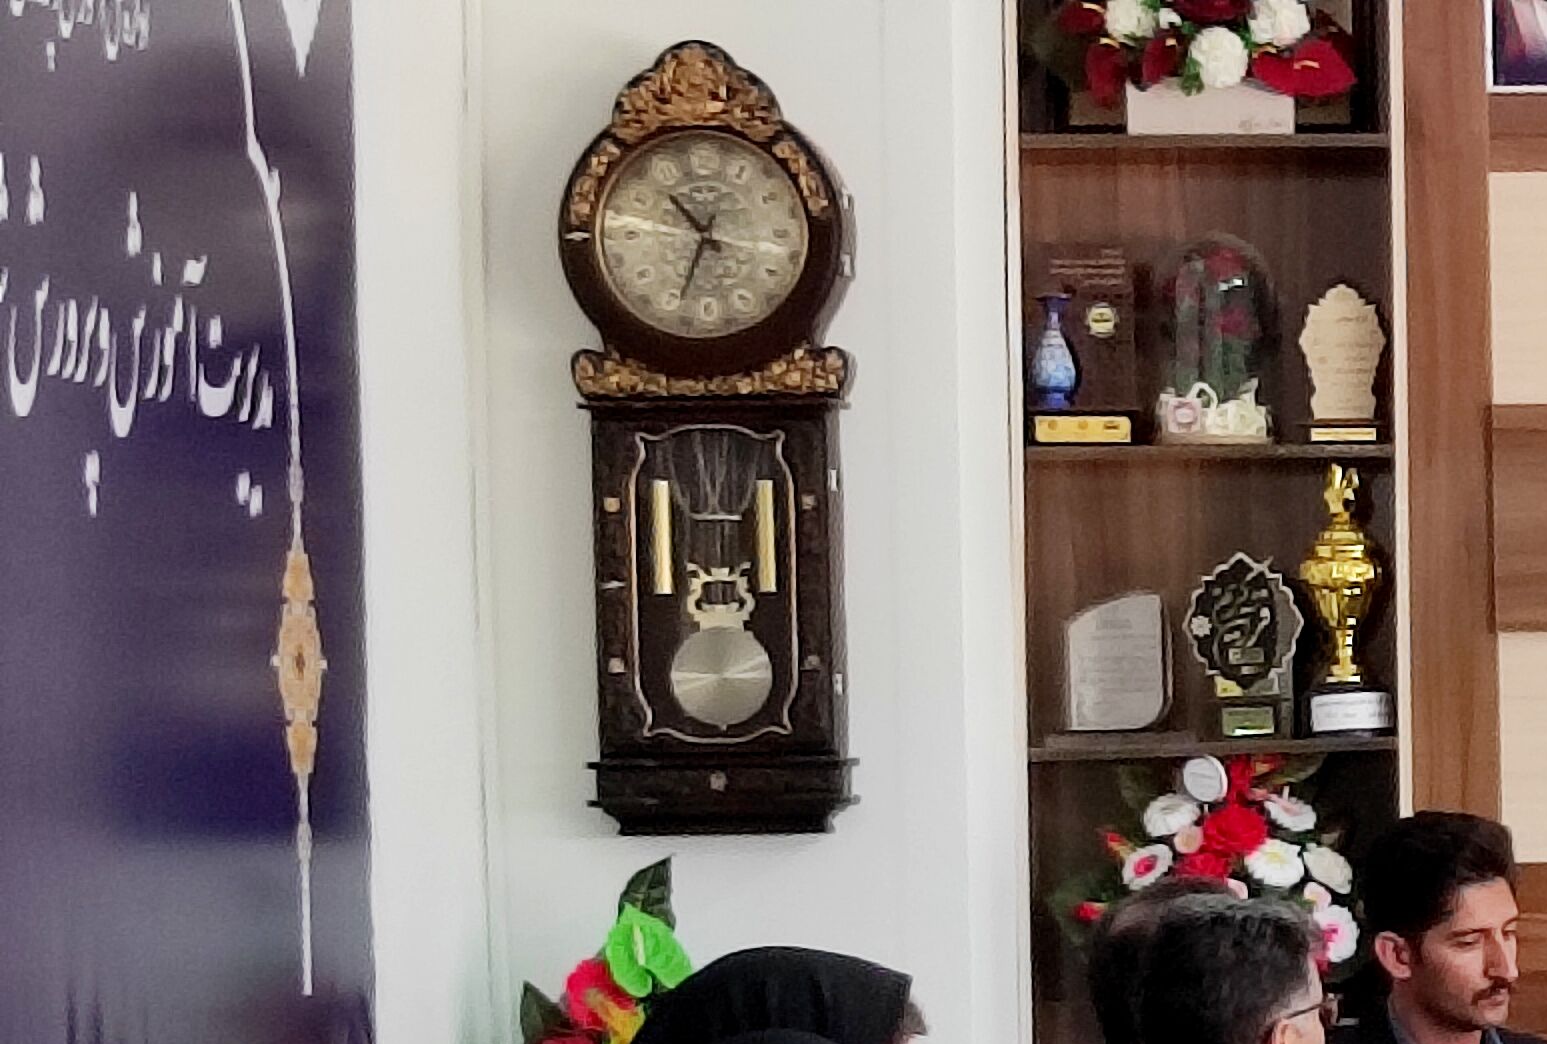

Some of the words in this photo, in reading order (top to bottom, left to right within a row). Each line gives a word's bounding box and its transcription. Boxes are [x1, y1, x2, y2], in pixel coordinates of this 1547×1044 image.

[8, 155, 99, 517] پرورش
[110, 191, 207, 438] آموزش
[198, 314, 274, 517] مدیریت
